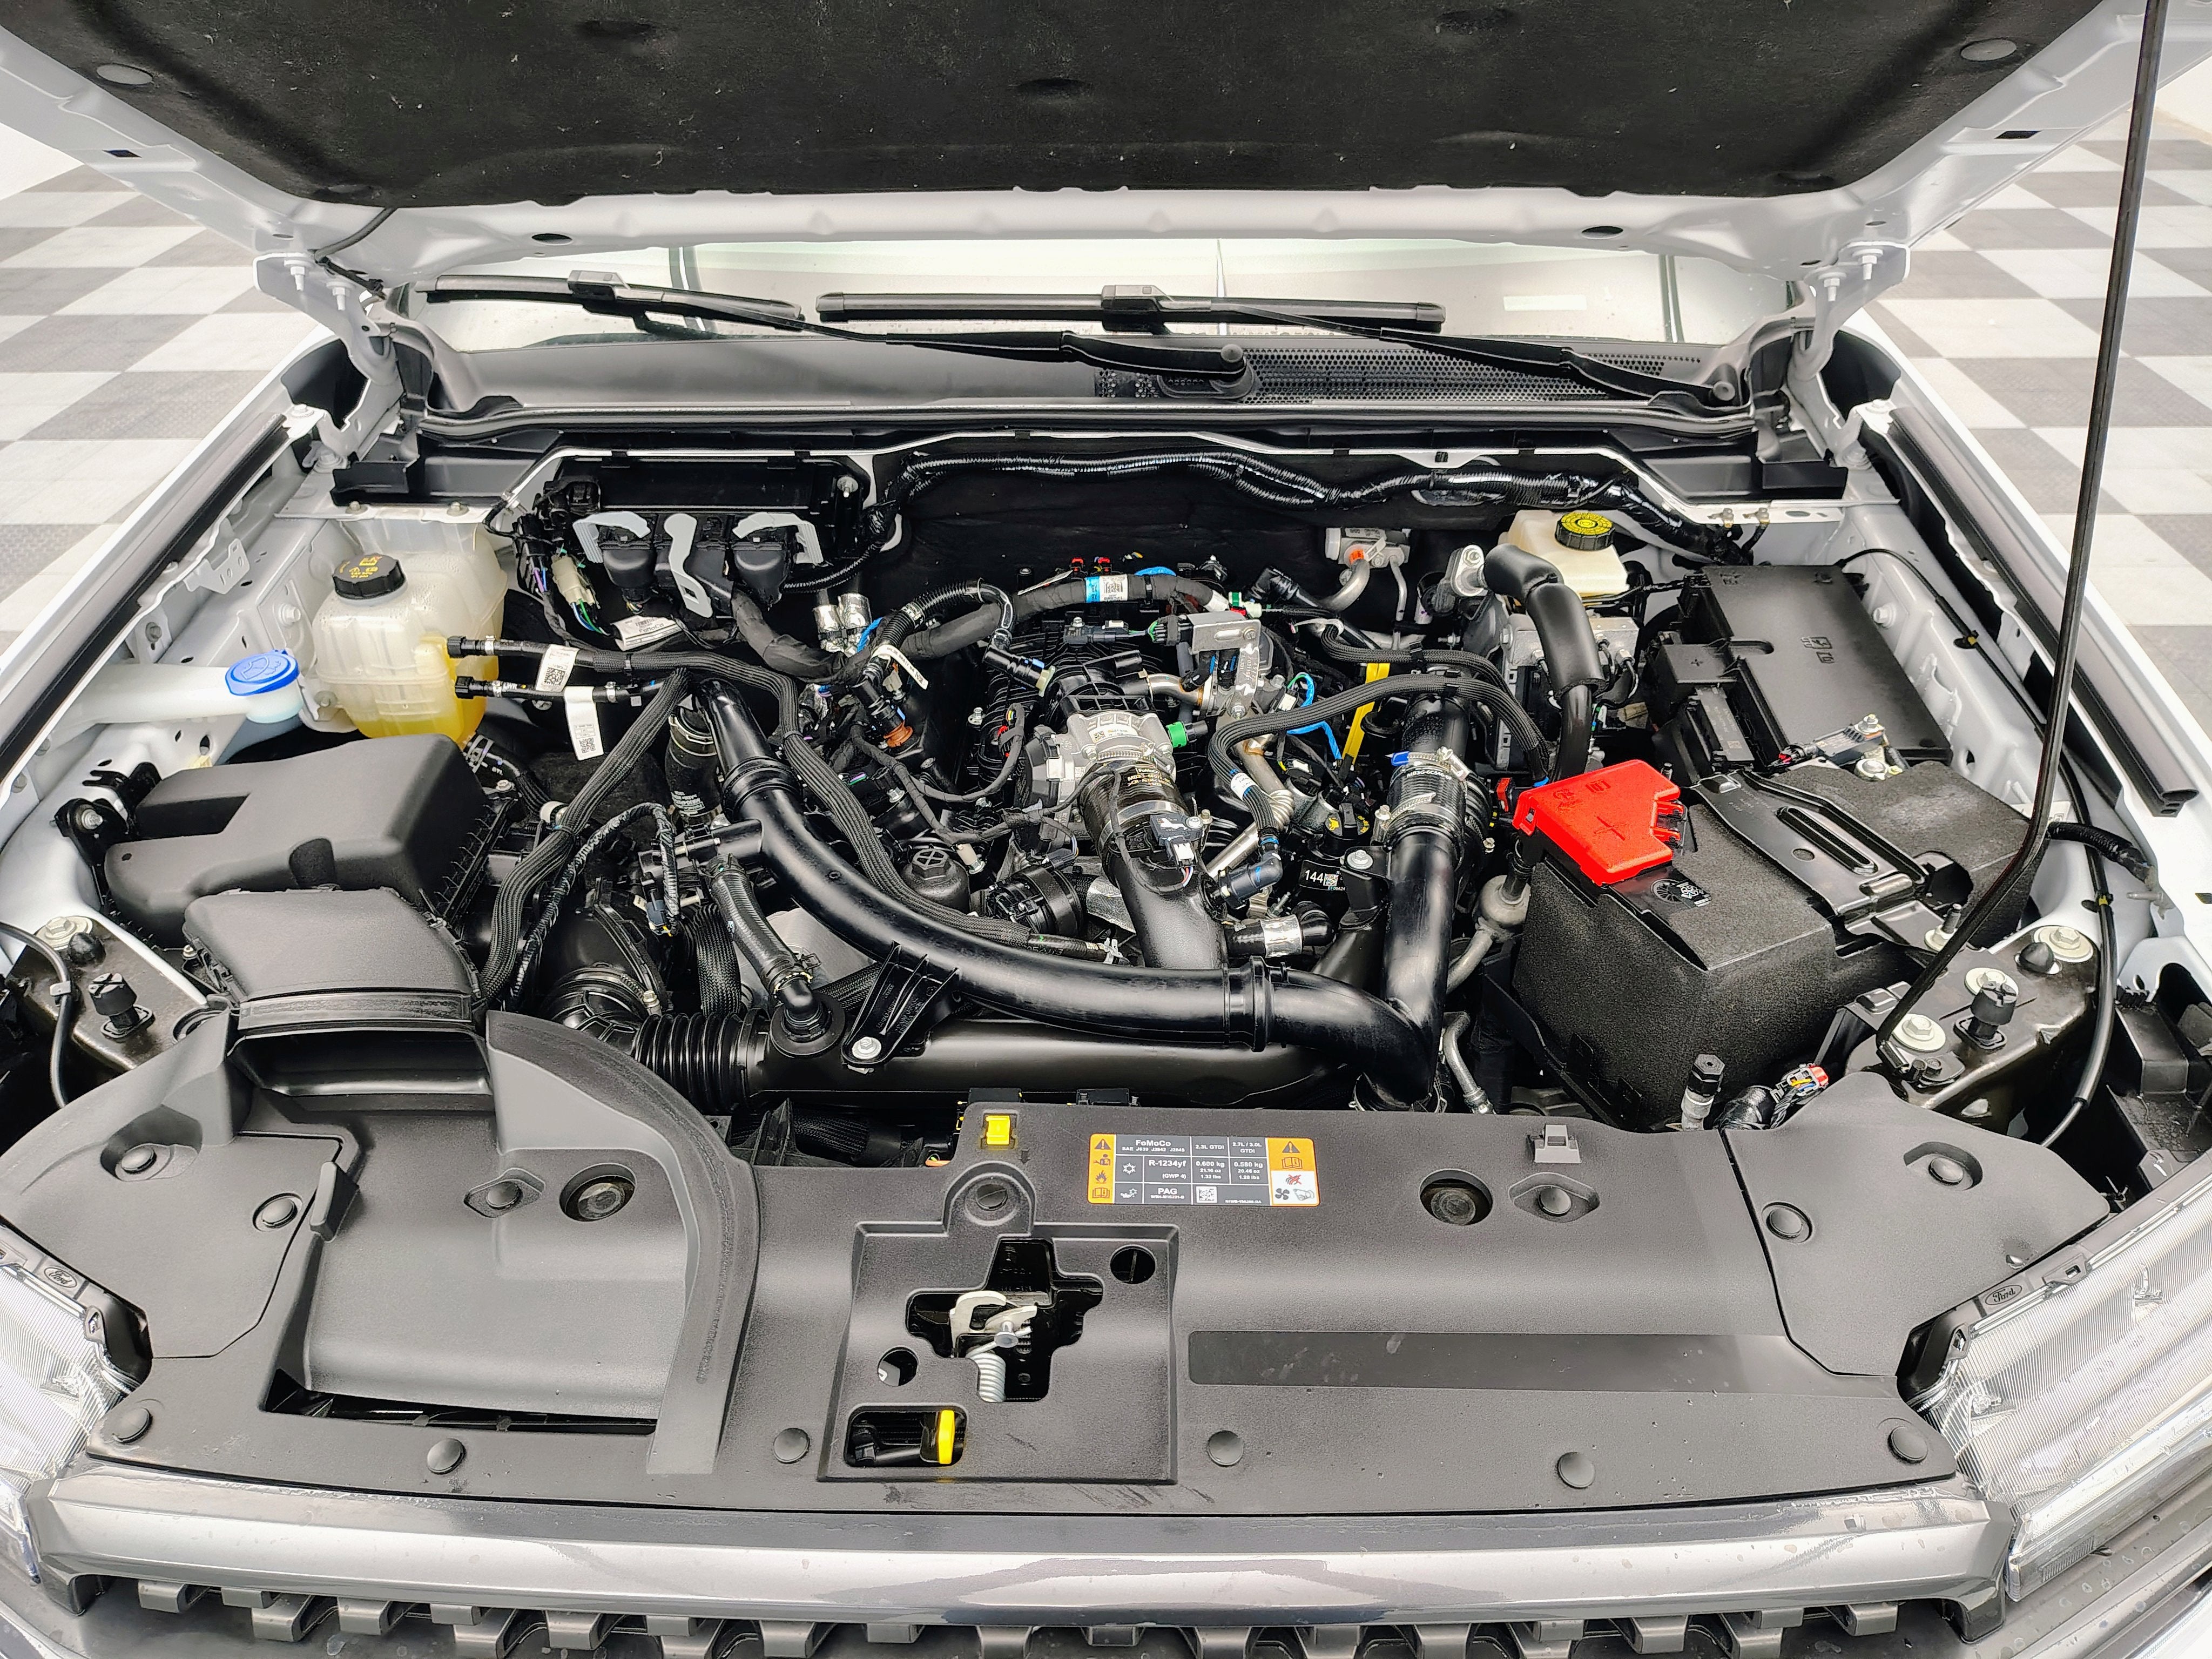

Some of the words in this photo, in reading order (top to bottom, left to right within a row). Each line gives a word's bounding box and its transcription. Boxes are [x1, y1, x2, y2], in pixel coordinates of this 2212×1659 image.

[639, 623, 664, 633] FoMoCo
[1305, 869, 1323, 884] 144
[1149, 1159, 1186, 1168] R-1234yf
[48, 1270, 73, 1285] Ford
[1992, 1287, 2016, 1303] Ford
